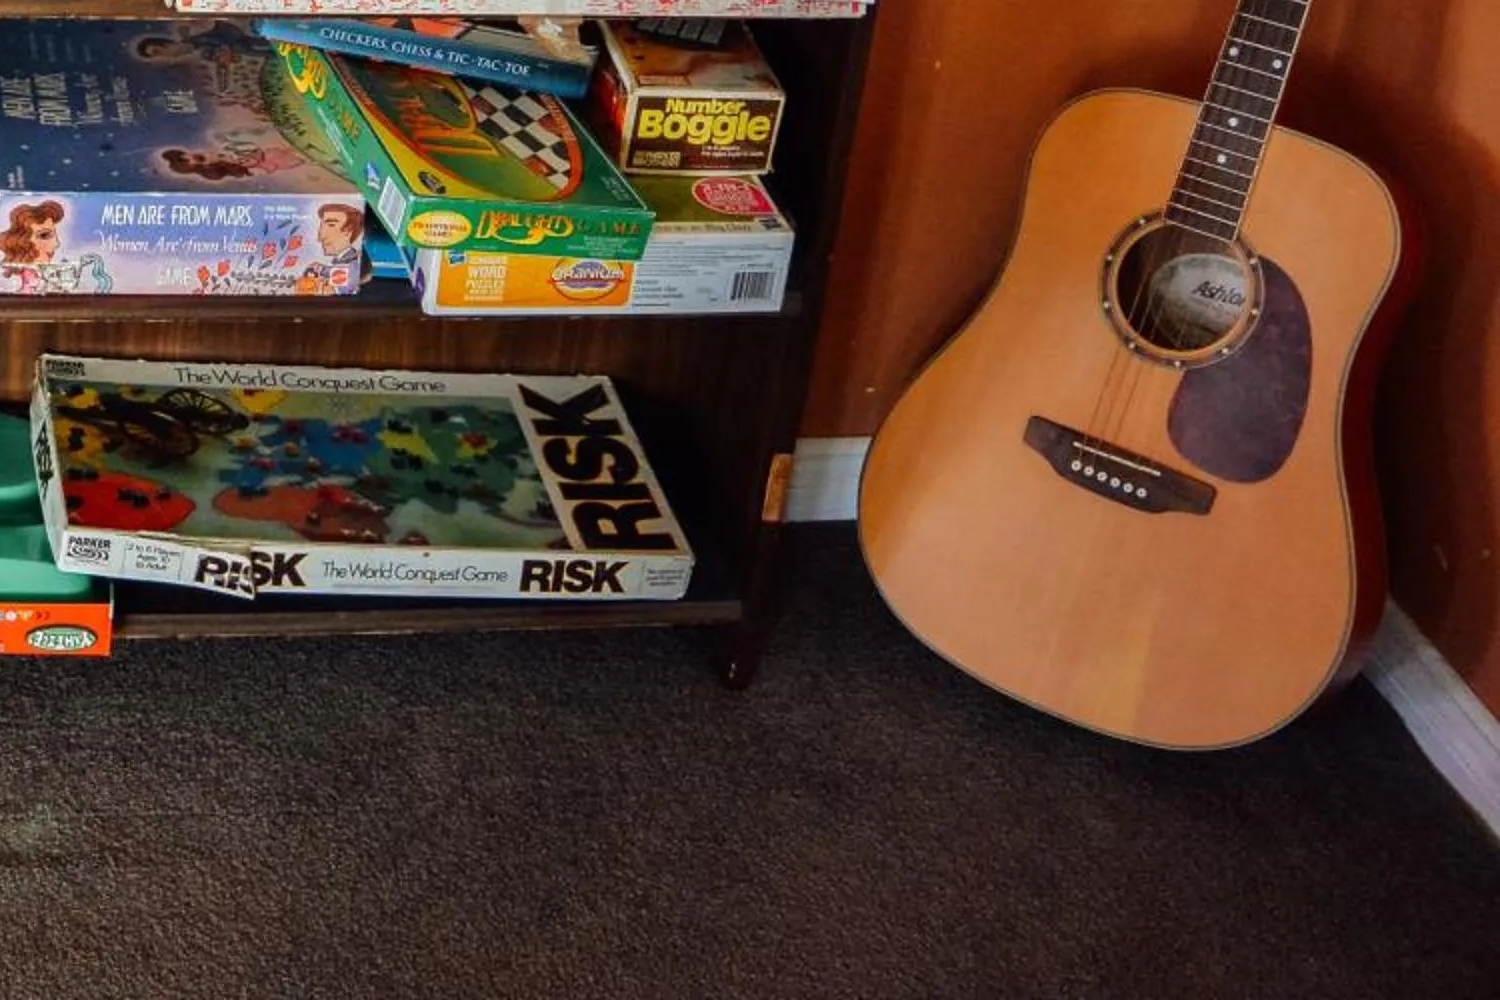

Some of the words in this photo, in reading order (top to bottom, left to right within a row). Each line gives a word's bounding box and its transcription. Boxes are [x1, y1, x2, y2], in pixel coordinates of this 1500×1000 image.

[319, 26, 390, 50] CHECKERS,
[390, 41, 434, 59] CHESS
[665, 97, 748, 114] Number
[637, 108, 772, 146] Boggle
[100, 204, 133, 226] MEN
[137, 204, 165, 226] ARE
[171, 204, 208, 227] FROM
[176, 367, 212, 385] The
[212, 369, 278, 387] World
[280, 372, 377, 394] Conquest
[378, 375, 447, 393] Game
[516, 382, 679, 552] RISK
[67, 535, 112, 549] PARKER
[323, 561, 348, 579] The
[347, 562, 395, 579] World
[395, 563, 463, 584] Conquest
[463, 564, 508, 583] Game
[518, 560, 629, 594] RISK
